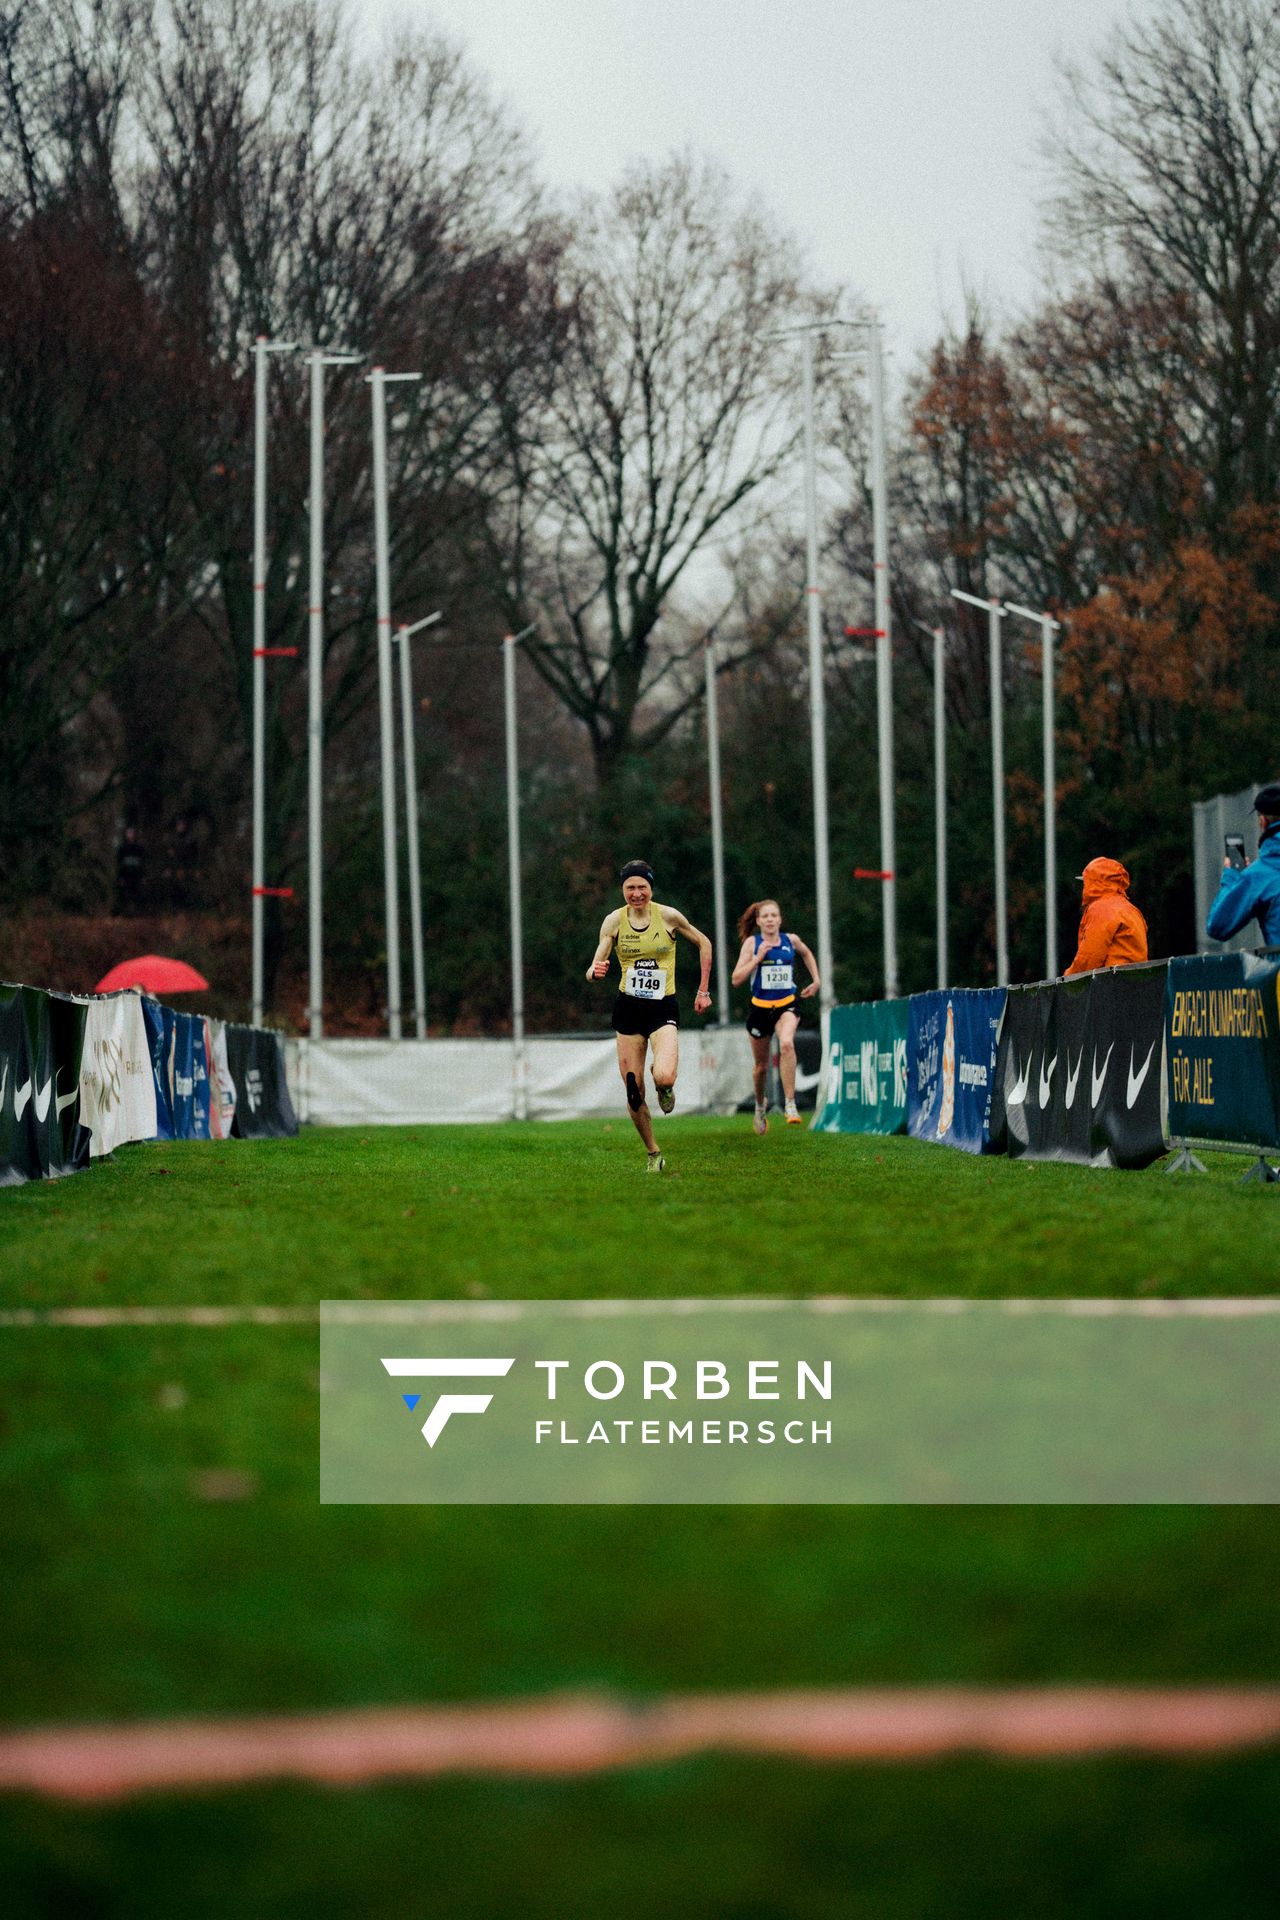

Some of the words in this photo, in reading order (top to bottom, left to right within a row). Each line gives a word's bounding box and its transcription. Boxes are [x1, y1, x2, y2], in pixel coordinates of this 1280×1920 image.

[631, 977, 660, 990] 1149
[766, 973, 788, 982] 1230
[1172, 990, 1207, 1037] EINFACH
[1172, 1049, 1191, 1104] FÜR
[1193, 1058, 1215, 1104] ALLE
